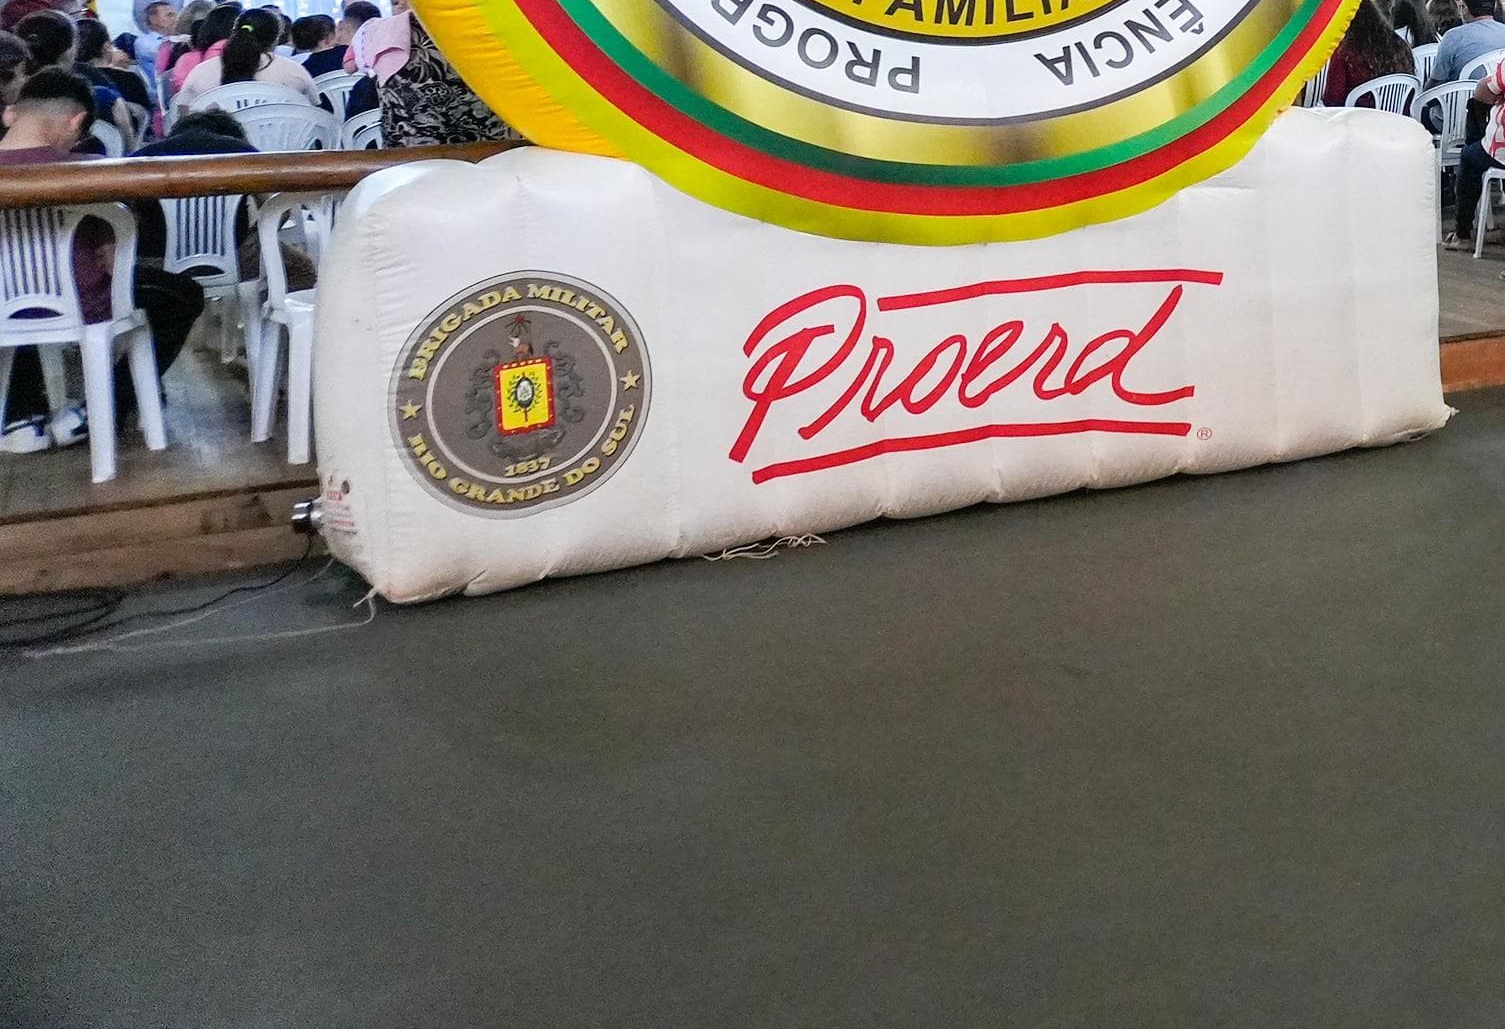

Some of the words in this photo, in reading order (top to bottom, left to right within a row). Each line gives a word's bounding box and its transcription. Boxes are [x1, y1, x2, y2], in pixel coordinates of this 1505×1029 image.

[408, 286, 522, 380] BRIGADA
[527, 284, 630, 354] MILITAR
[729, 282, 1200, 463] Proerd
[407, 433, 447, 480] RIO
[451, 478, 561, 504] GRANDE
[563, 456, 600, 486] DO
[601, 404, 636, 457] SUL
[504, 454, 552, 478] 1837
